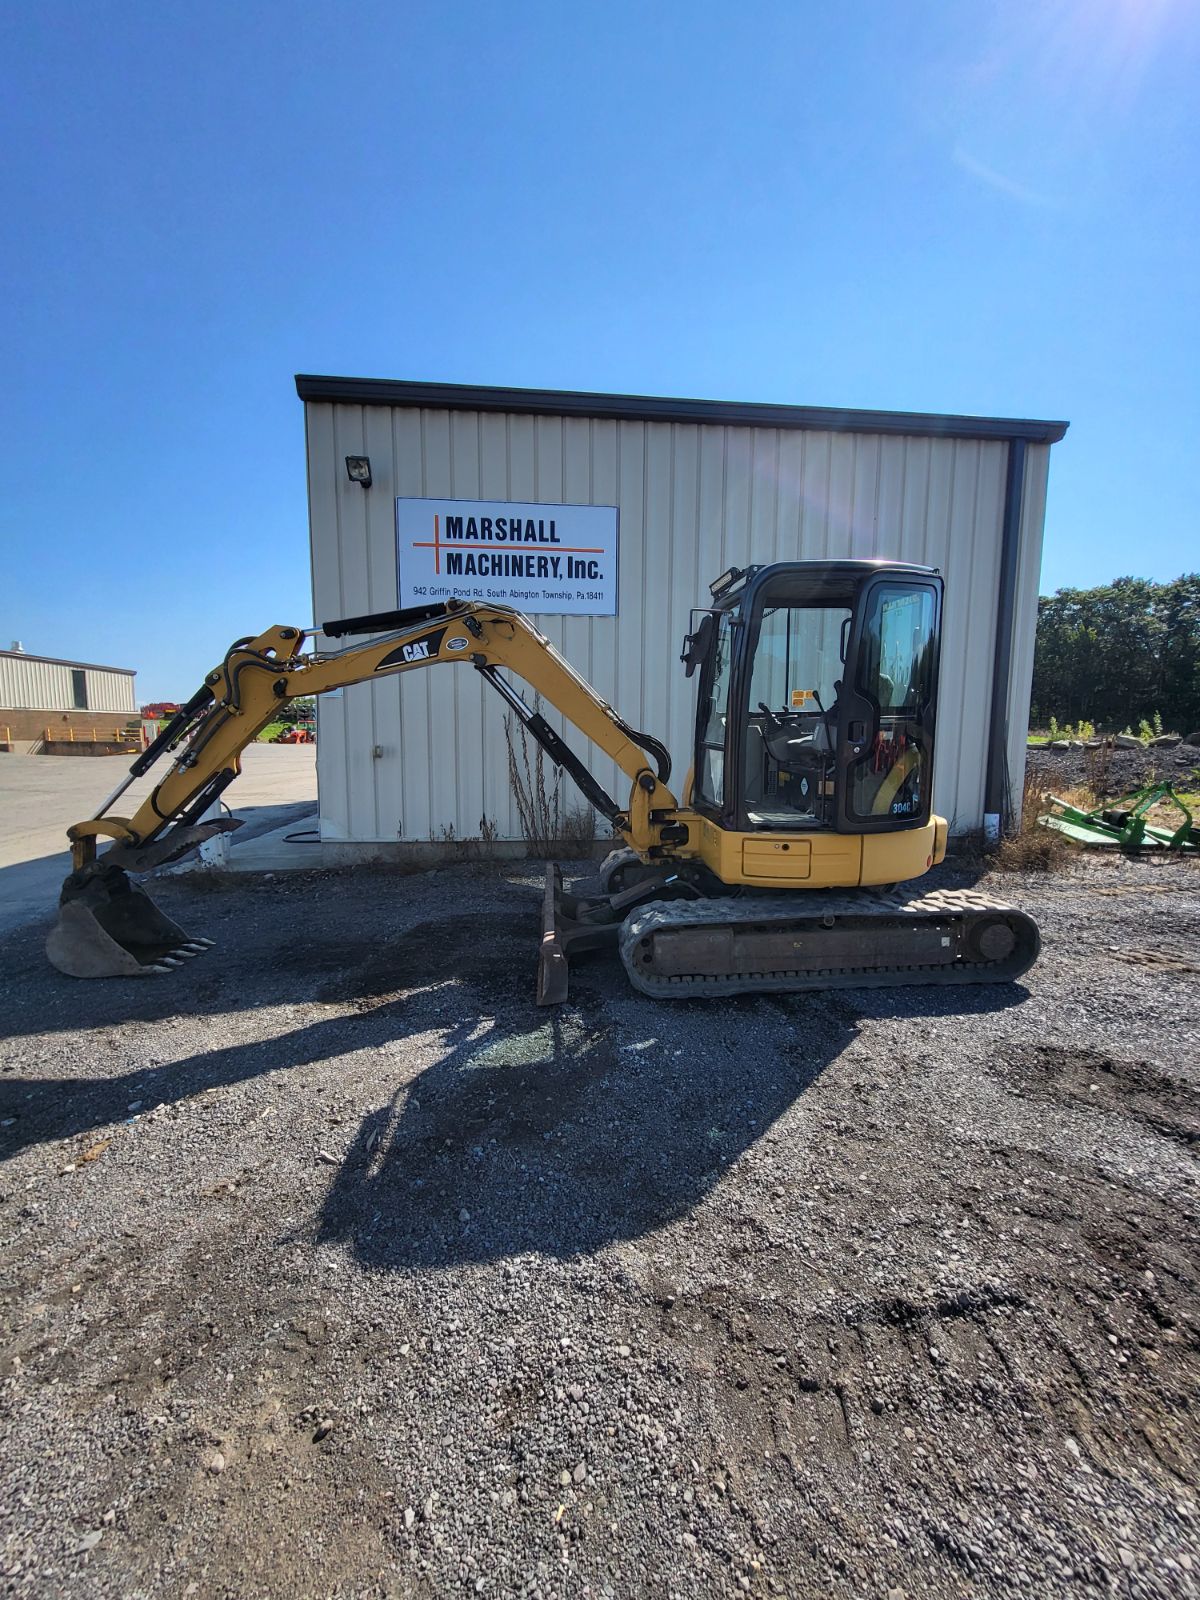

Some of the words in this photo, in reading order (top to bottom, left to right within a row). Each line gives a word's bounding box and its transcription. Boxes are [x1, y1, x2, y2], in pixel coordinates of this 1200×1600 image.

[445, 516, 561, 543] MARSHALL
[446, 552, 563, 581] MACHINERY,
[567, 555, 604, 579] Inc.
[413, 586, 427, 596] 942
[429, 586, 451, 596] Griffin
[453, 587, 471, 597] Pond
[473, 588, 484, 597] Rd.
[486, 588, 507, 598] South
[509, 589, 540, 600] Abington
[541, 590, 575, 601] Township,
[402, 641, 430, 663] CAT
